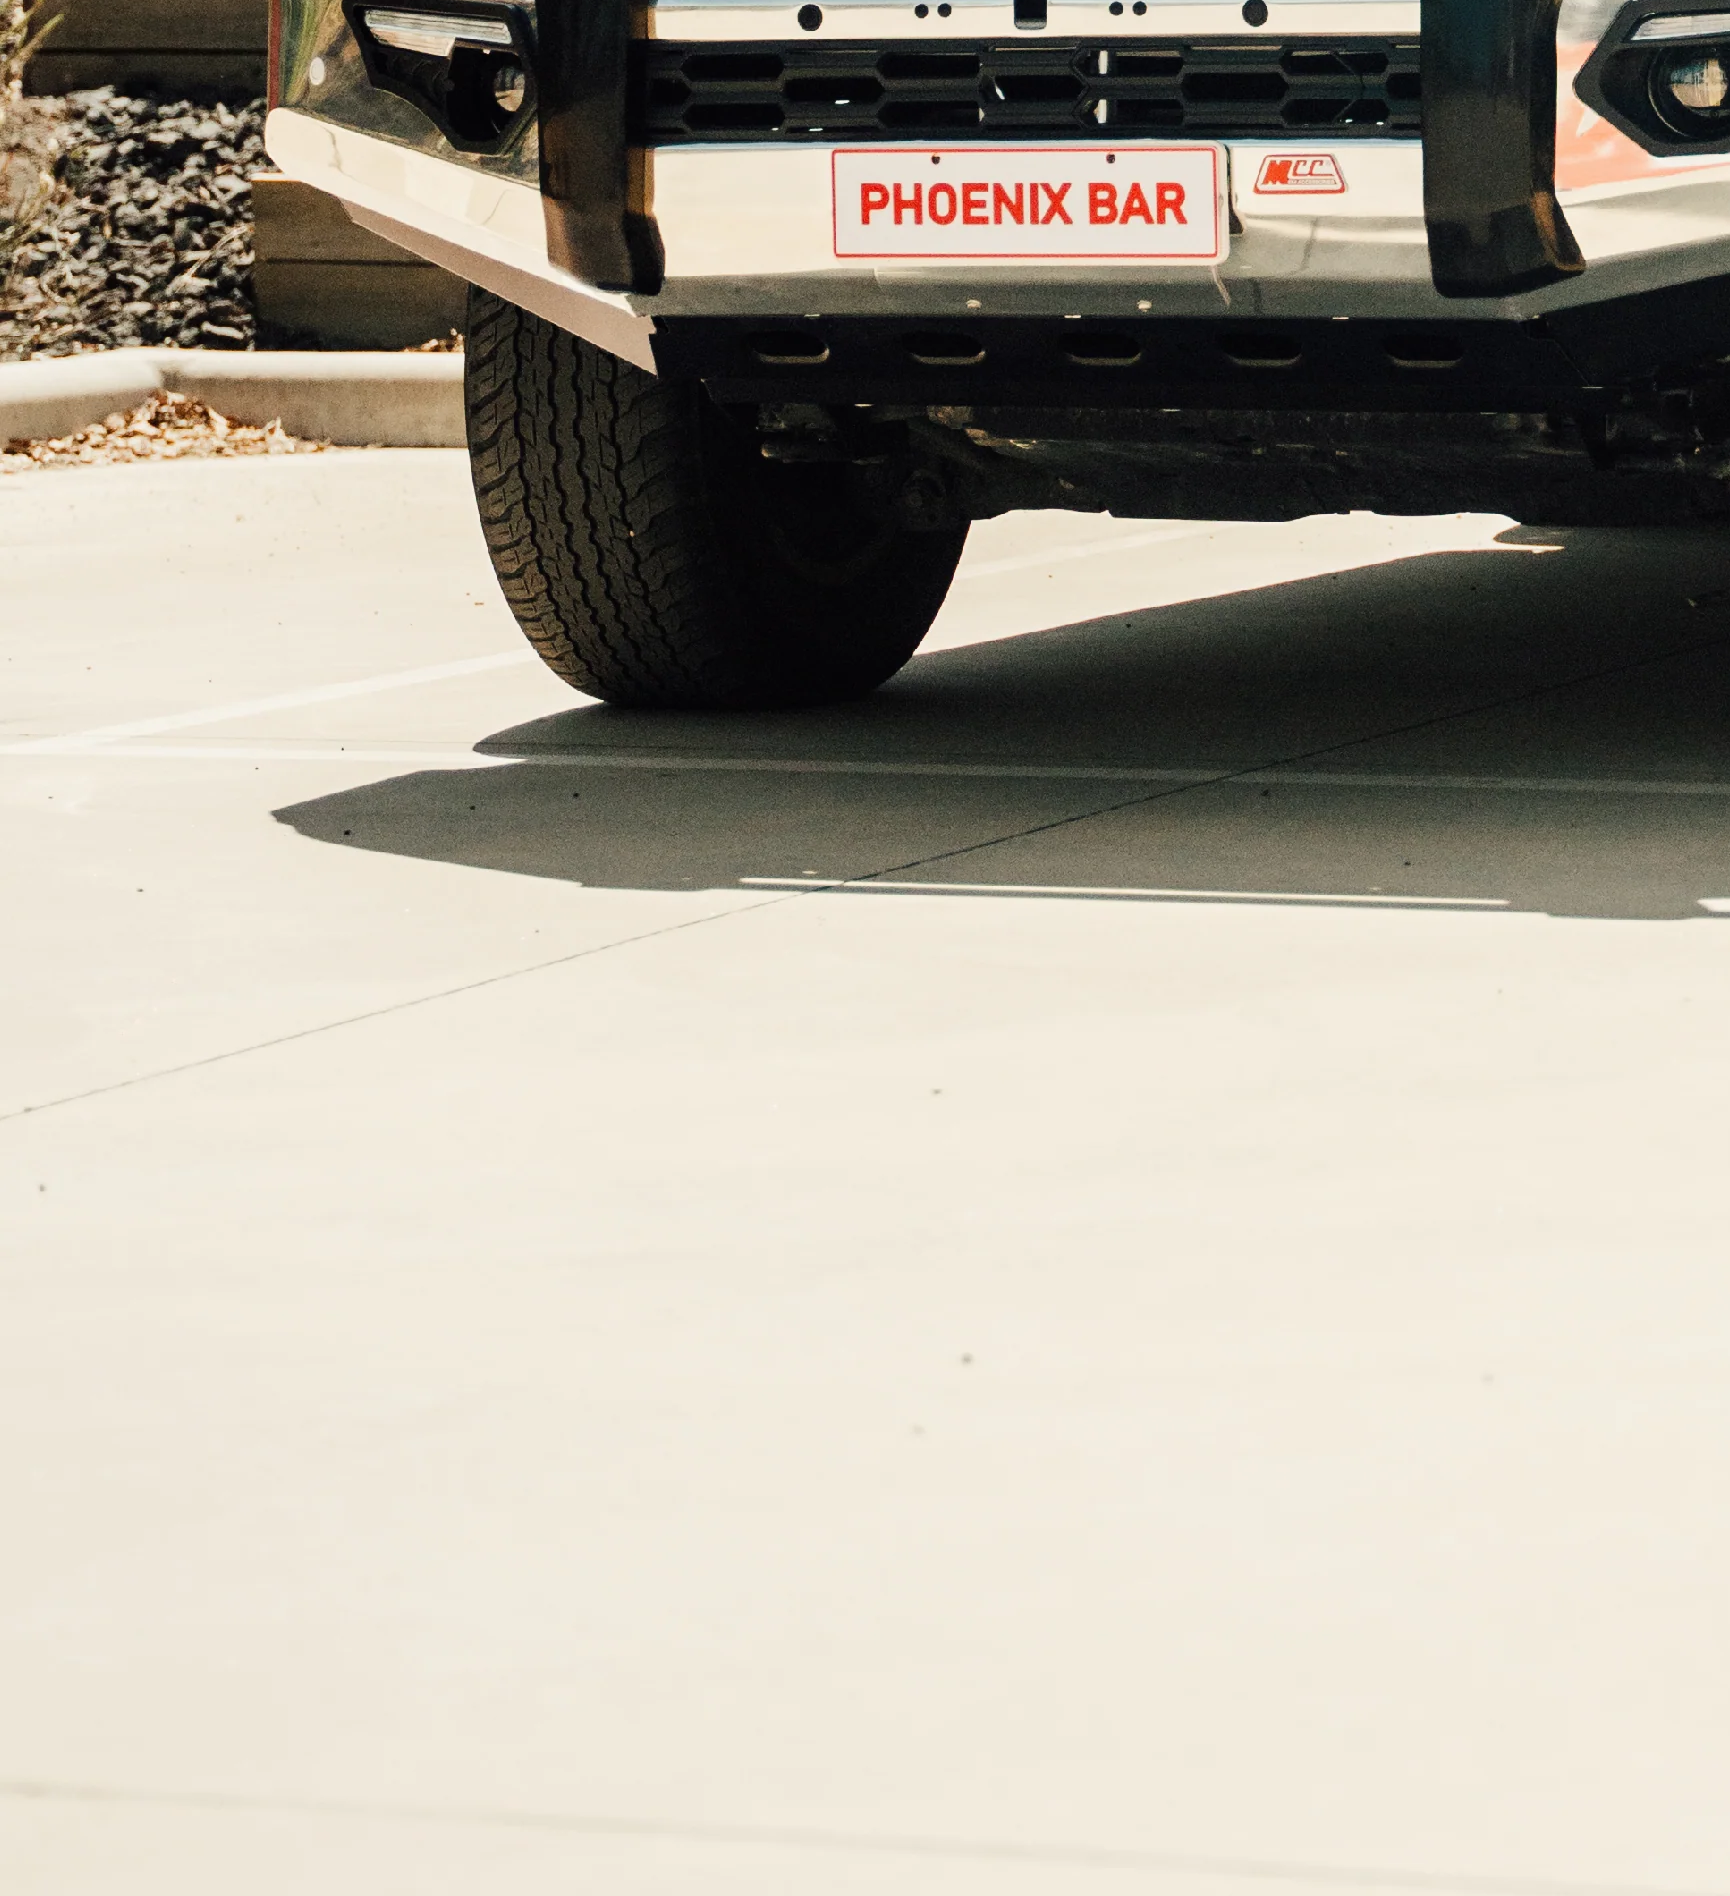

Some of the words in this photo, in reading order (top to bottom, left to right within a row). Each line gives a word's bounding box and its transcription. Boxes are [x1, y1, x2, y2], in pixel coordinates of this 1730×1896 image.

[1262, 159, 1334, 185] MCC
[860, 182, 1074, 225] PHOENIX
[1087, 182, 1188, 225] BAR
